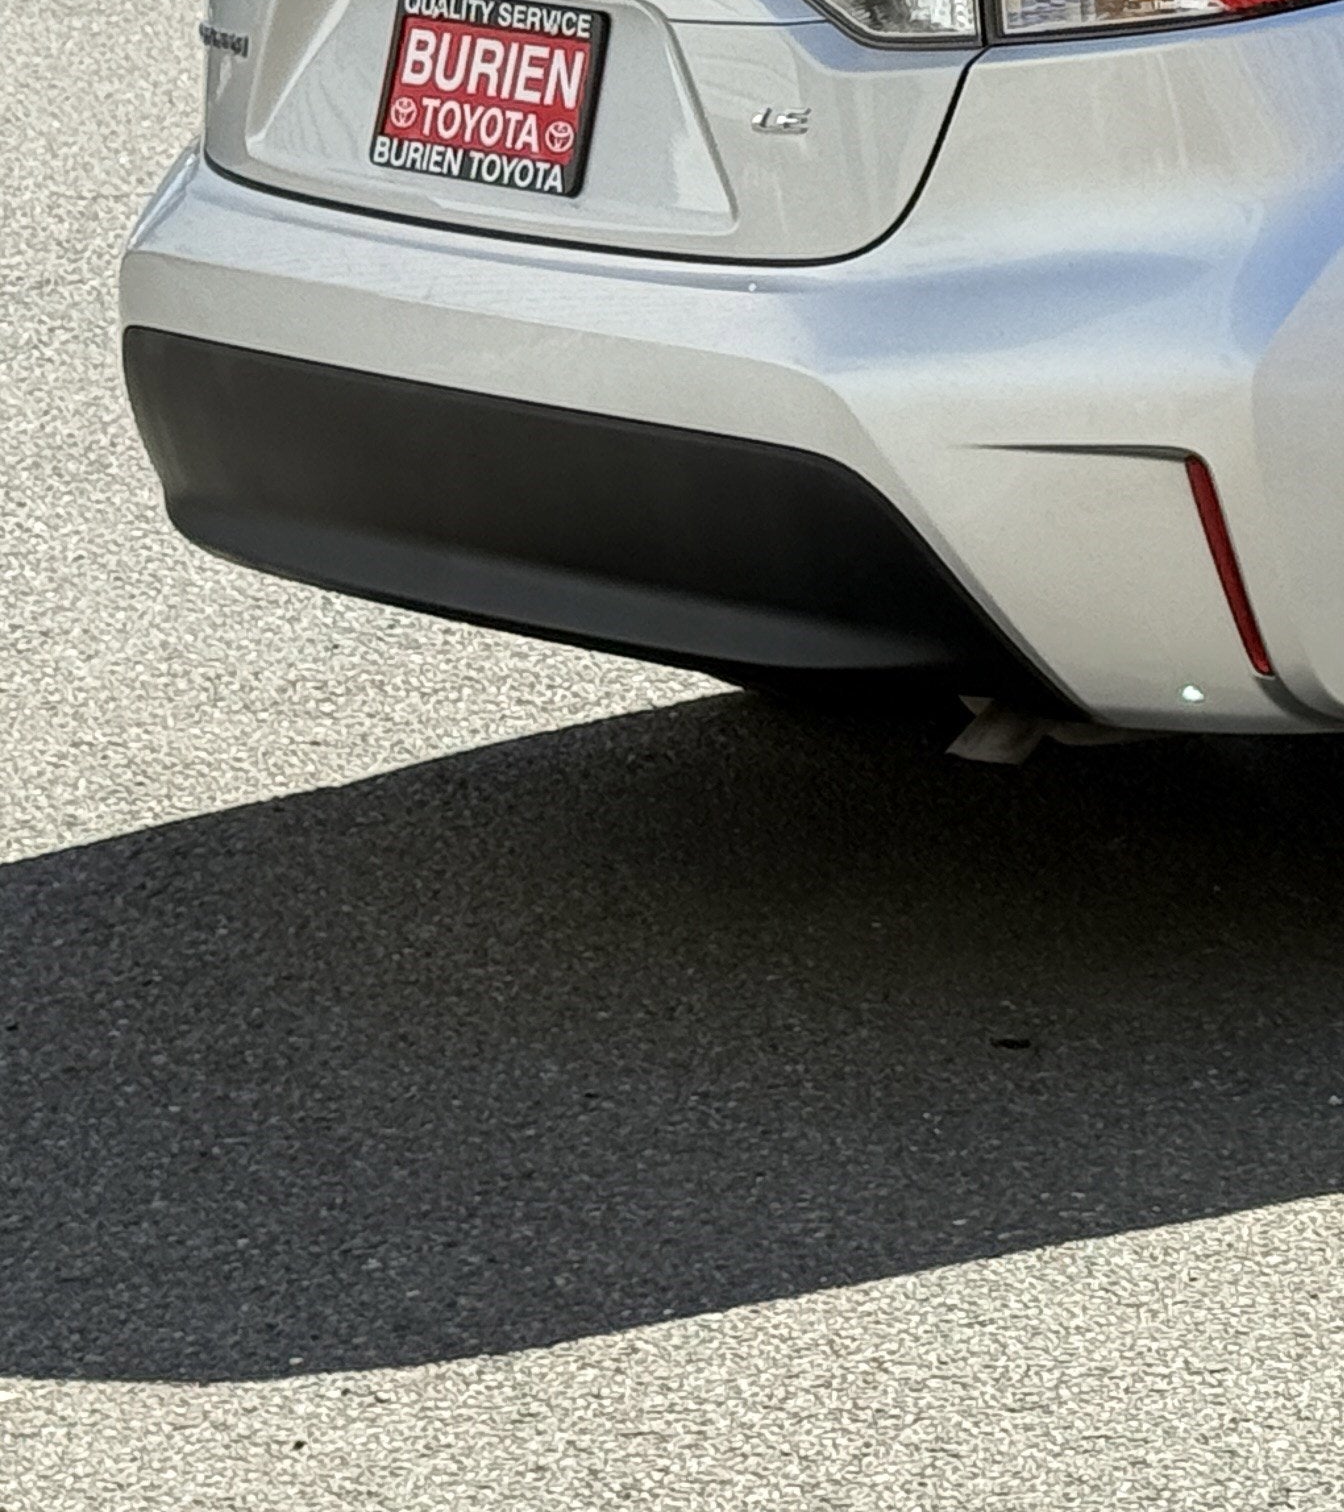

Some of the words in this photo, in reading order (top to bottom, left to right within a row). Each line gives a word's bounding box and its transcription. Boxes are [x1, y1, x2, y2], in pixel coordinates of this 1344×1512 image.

[498, 4, 592, 38] SERVICE
[401, 28, 585, 110] BURIEN
[421, 97, 540, 153] TOYOTA
[751, 107, 812, 135] LE
[373, 136, 463, 177] BURIEN
[469, 151, 564, 193] TOYOTA
